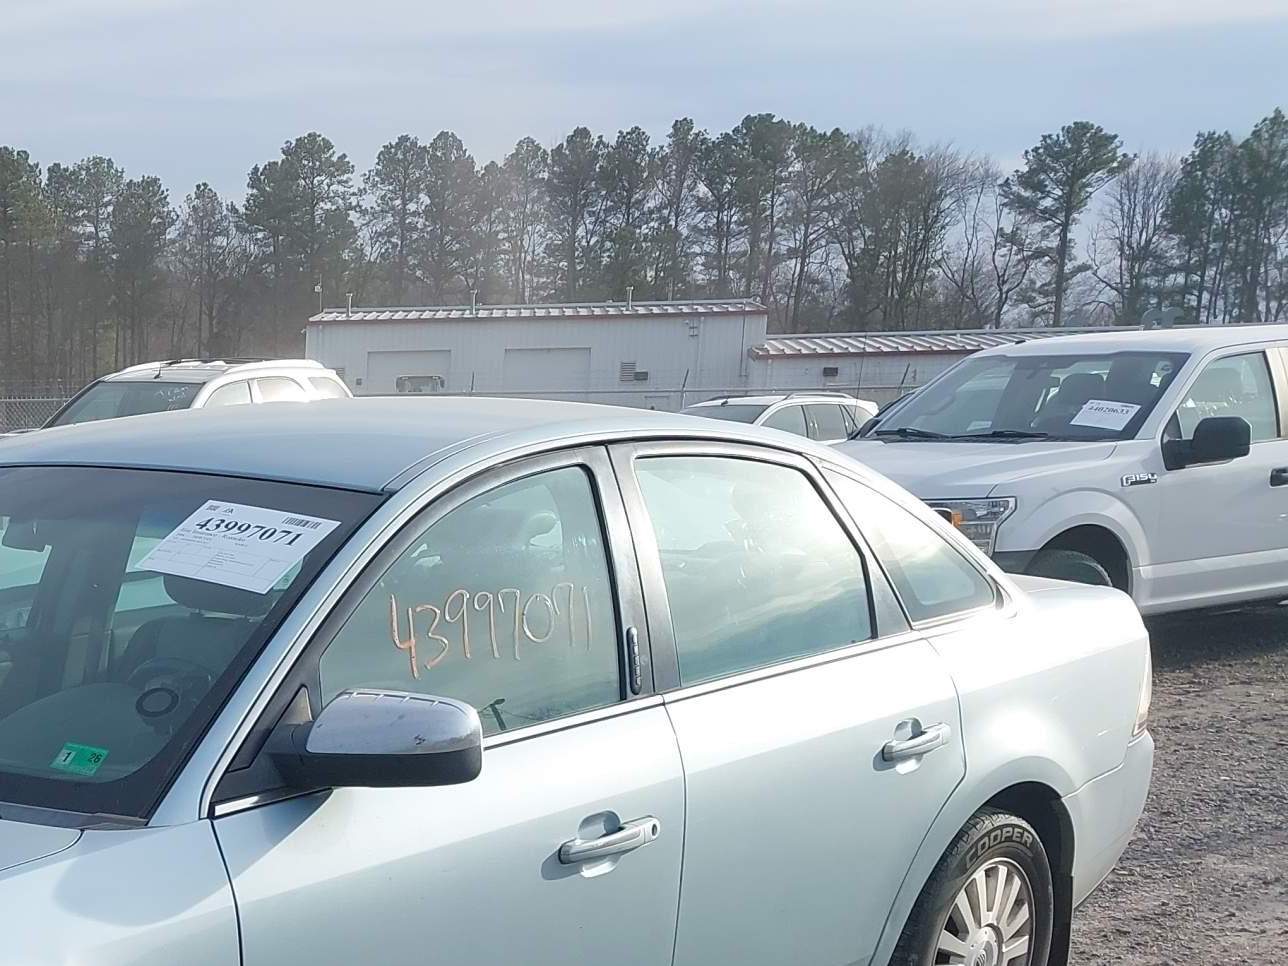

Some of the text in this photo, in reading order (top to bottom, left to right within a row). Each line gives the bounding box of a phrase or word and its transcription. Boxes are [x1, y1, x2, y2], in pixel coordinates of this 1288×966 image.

[195, 517, 305, 546] 43997071
[390, 583, 592, 681] 43997071
[62, 751, 73, 763] 1
[965, 827, 1033, 869] COOPER
